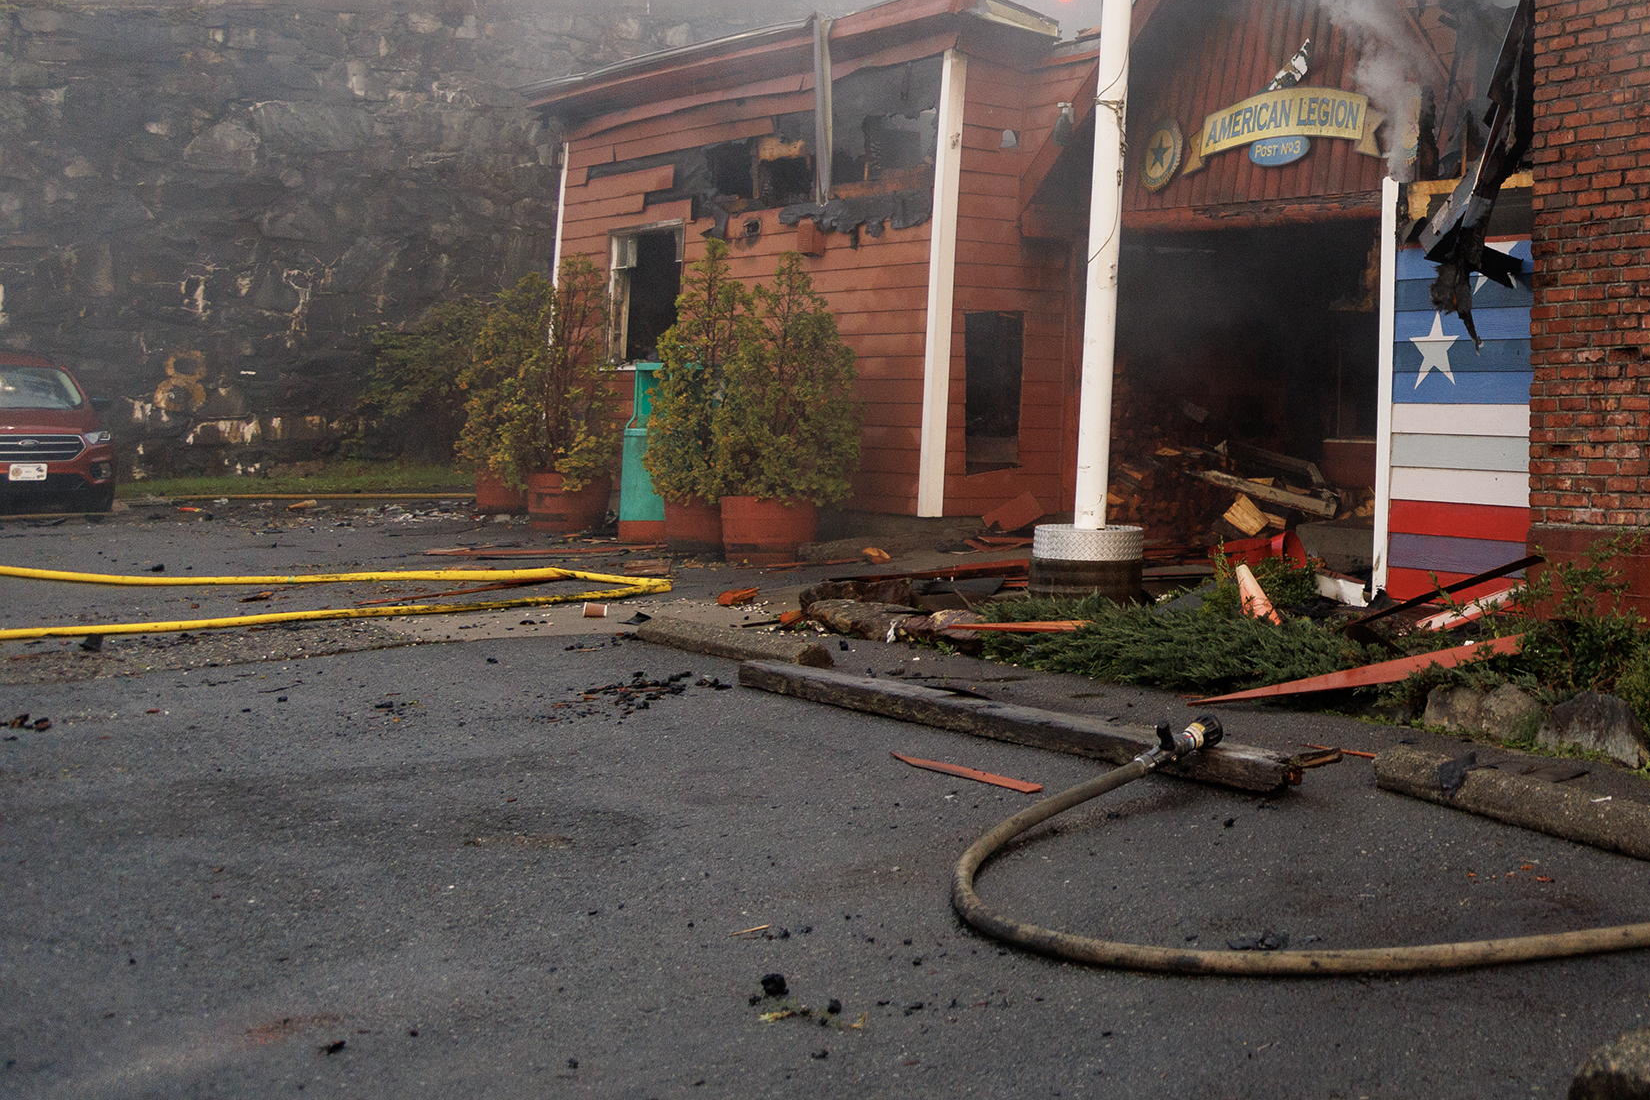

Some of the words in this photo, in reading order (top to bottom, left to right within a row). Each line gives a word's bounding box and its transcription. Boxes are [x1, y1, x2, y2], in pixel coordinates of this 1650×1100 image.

[1206, 100, 1293, 147] AMERICAN
[1297, 97, 1361, 130] LEGION
[1254, 144, 1278, 158] POST
